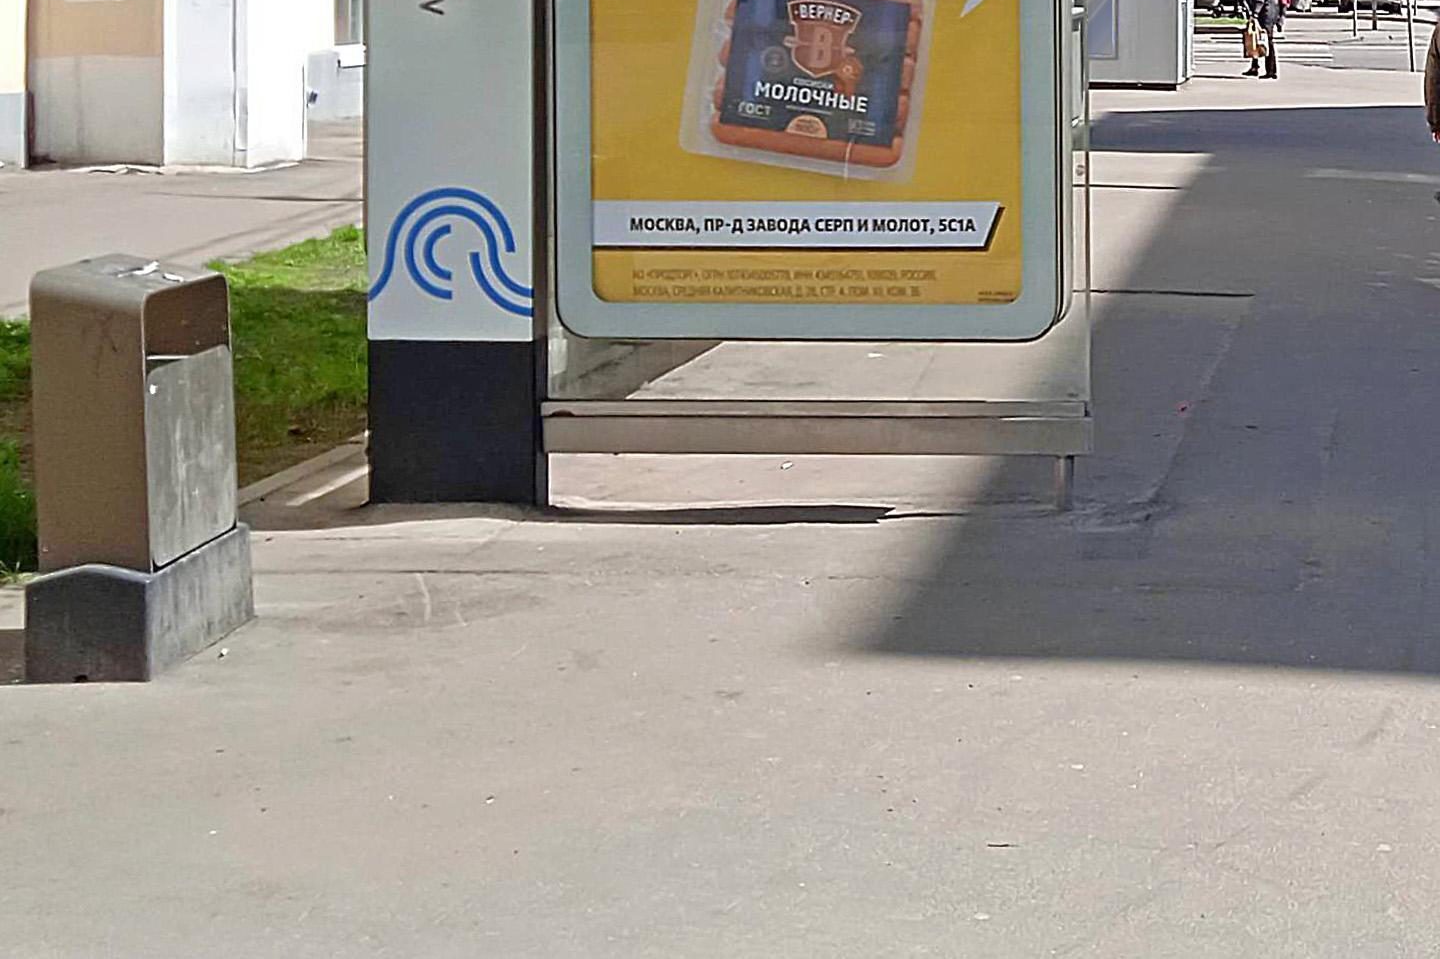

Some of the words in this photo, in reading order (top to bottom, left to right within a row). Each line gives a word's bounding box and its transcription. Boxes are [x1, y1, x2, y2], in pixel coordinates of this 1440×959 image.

[799, 3, 852, 24] ВЕРНЕР
[754, 81, 869, 114] МОЛОЧНЫЕ
[737, 101, 772, 116] ГОСТ
[630, 218, 700, 234] МОСКВА,
[704, 218, 744, 234] ПР-Д
[747, 218, 812, 234] ЗАВОДА
[815, 218, 853, 232] СЕРП
[857, 218, 868, 232] И
[872, 218, 935, 235] МОЛОТ,
[938, 218, 976, 232] 5С1А
